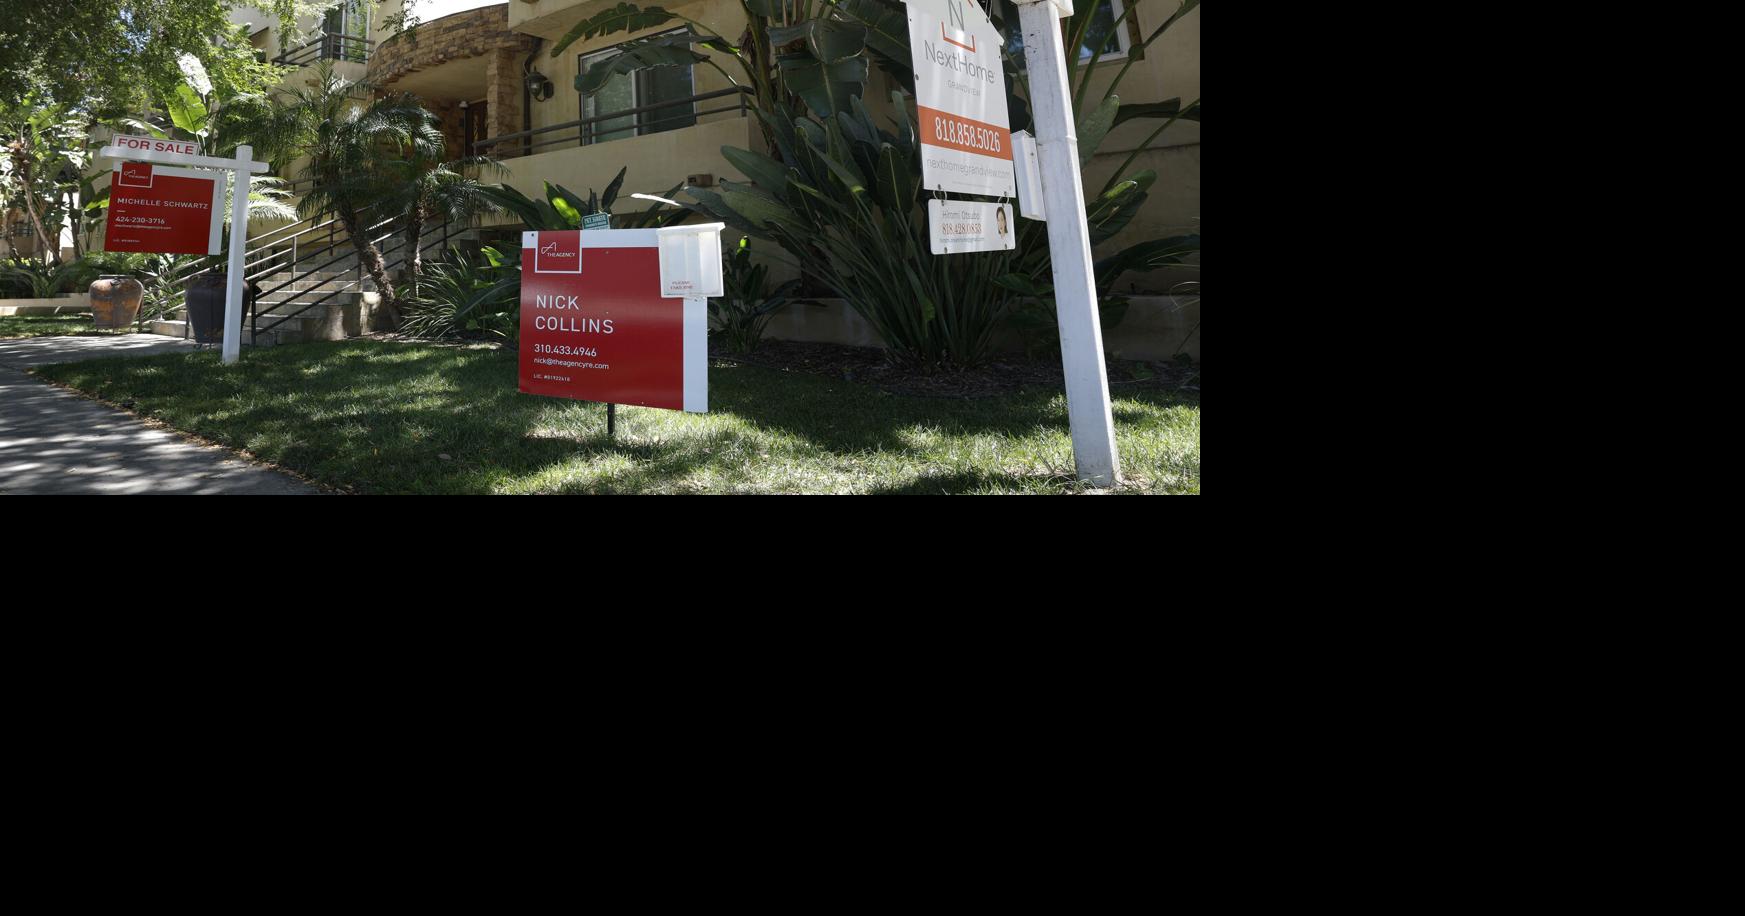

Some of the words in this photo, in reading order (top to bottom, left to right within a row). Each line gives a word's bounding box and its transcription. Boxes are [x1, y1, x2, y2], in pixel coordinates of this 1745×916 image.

[924, 39, 995, 84] NextHome
[935, 116, 1001, 152] 818.858.5026
[118, 137, 151, 151] FOR
[154, 141, 195, 155] SALE
[117, 197, 161, 207] MICHELLE
[163, 200, 209, 210] SCHWARTZ
[115, 216, 166, 225] 424-230-3716
[536, 294, 580, 310] NICK
[535, 315, 615, 334] COLLINS
[534, 343, 597, 357] 310.433.4946
[533, 358, 610, 370] nick@theagencyre.com
